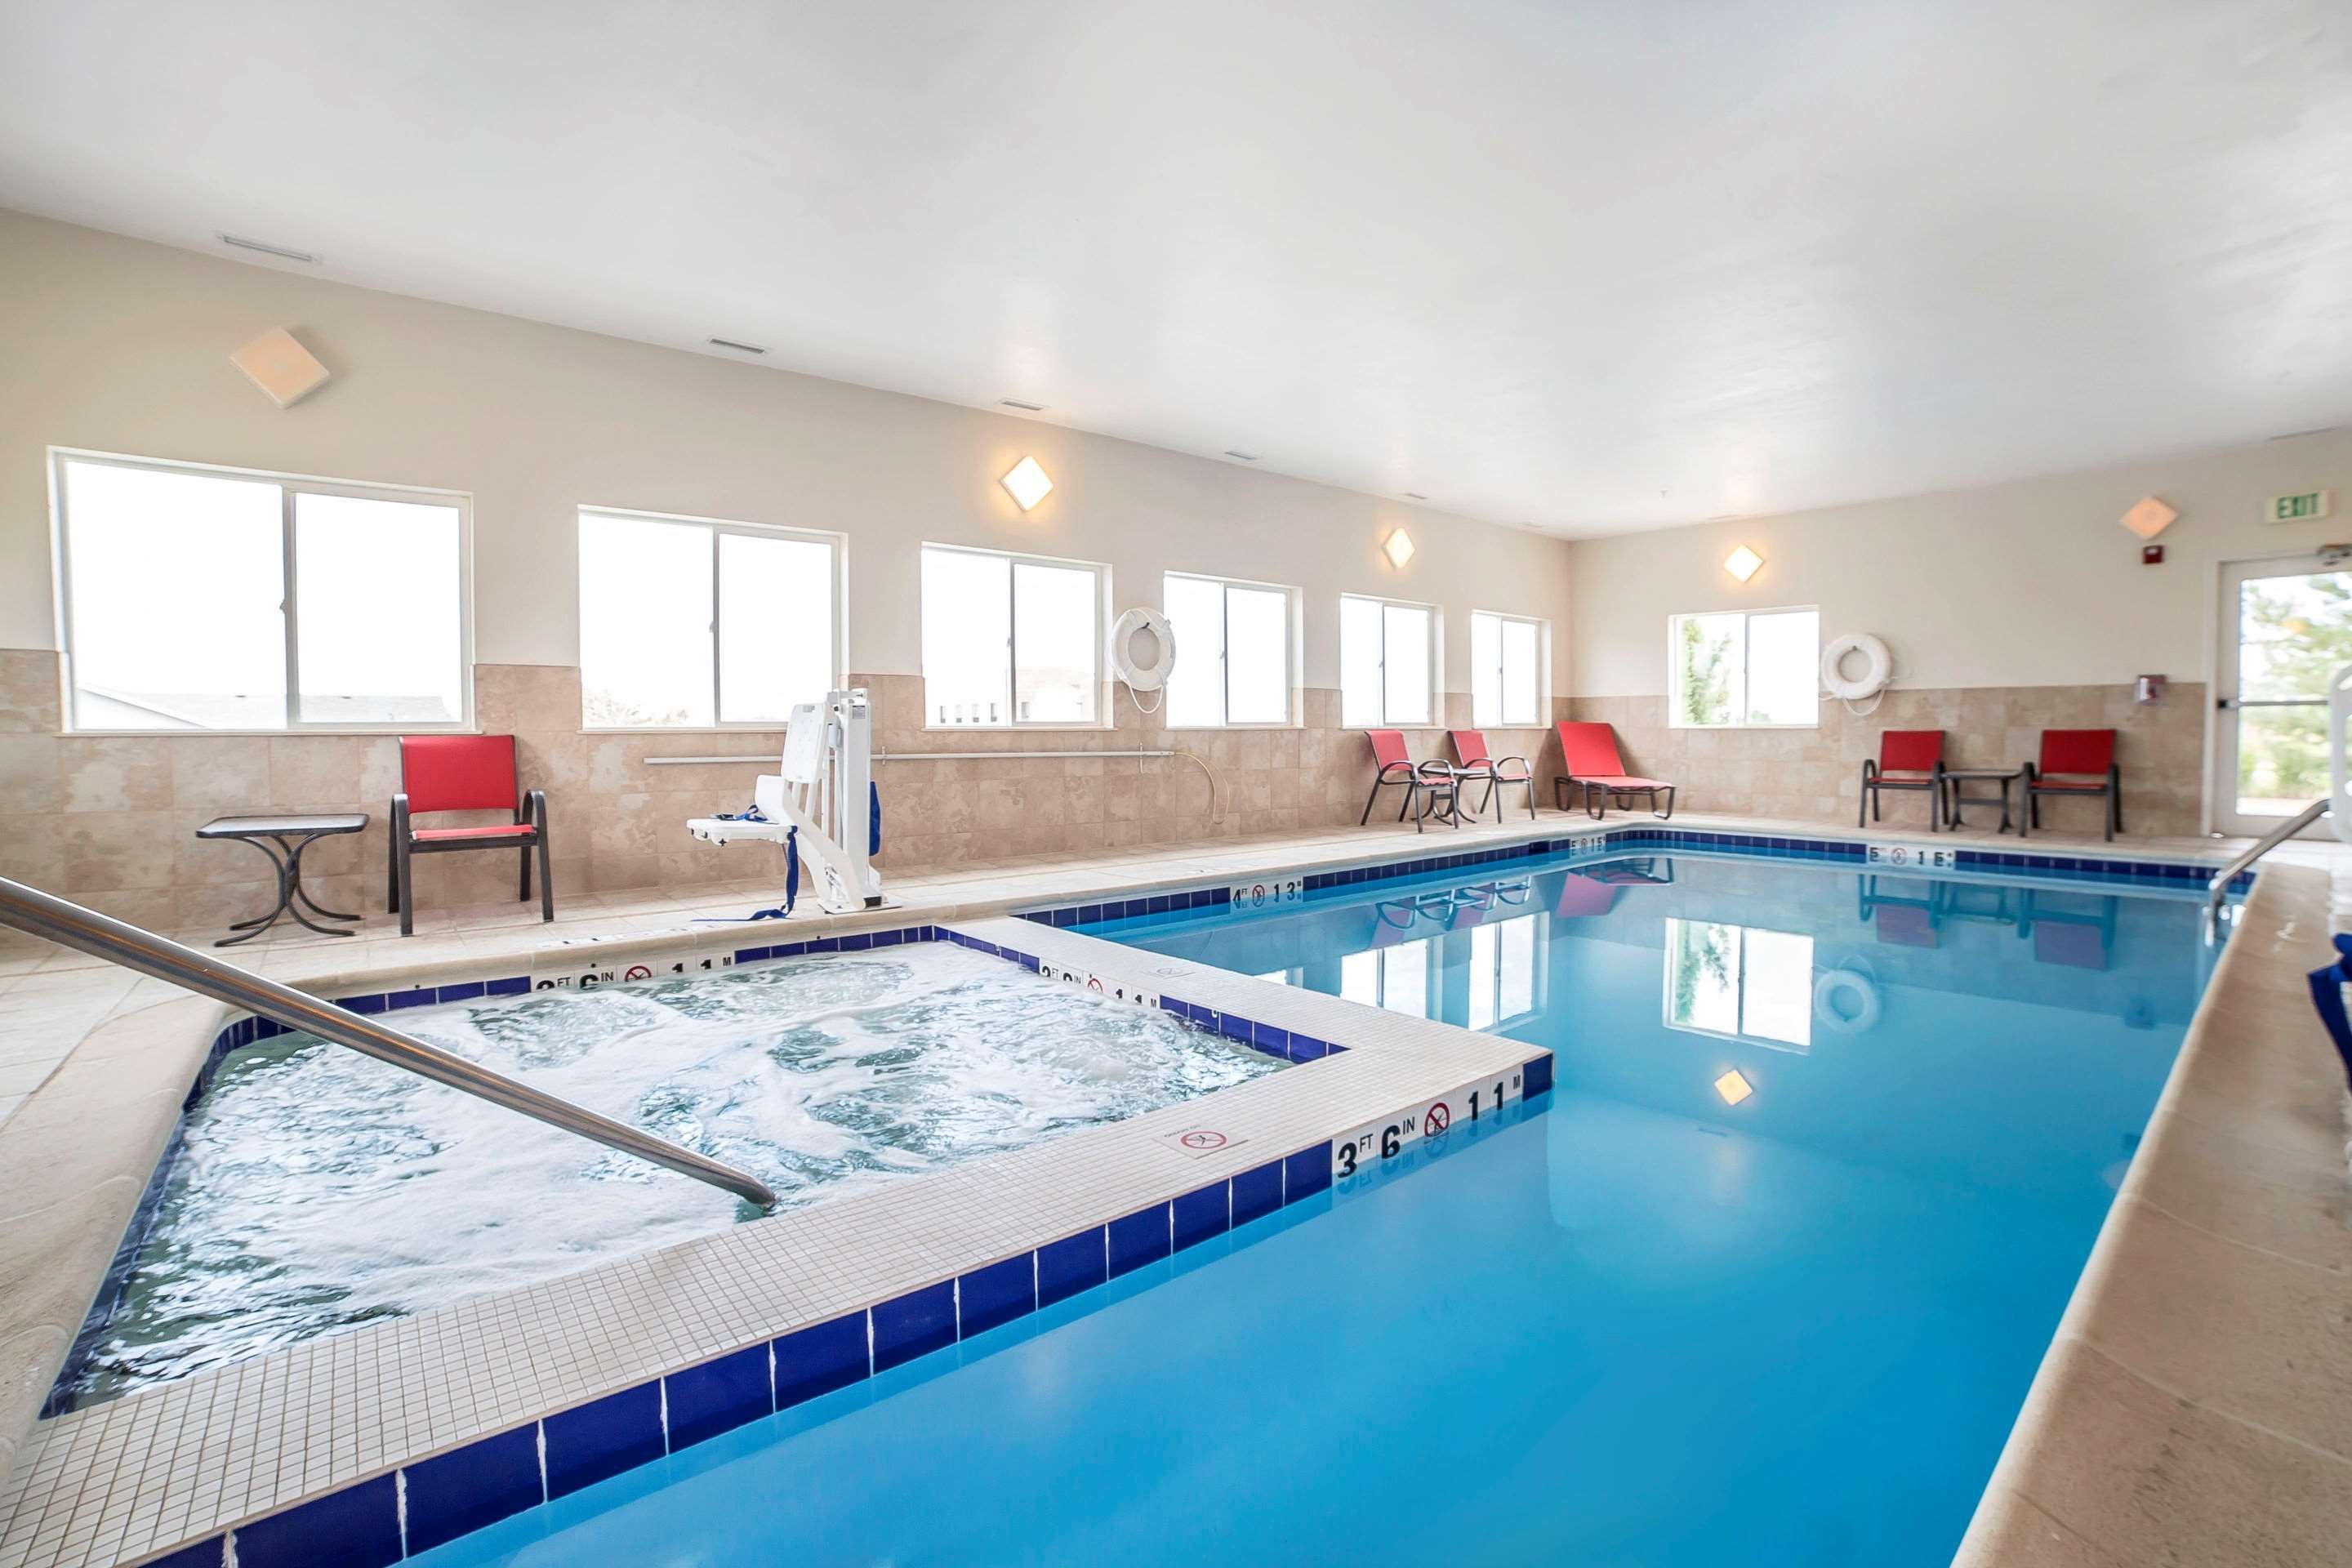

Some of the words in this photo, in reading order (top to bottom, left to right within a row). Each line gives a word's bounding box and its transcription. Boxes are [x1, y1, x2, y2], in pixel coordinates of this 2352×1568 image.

[2277, 493, 2318, 519] EXIT
[600, 972, 613, 982] IN
[723, 956, 731, 966] M
[1151, 998, 1156, 1008] M
[1338, 1143, 1357, 1178] 3
[1360, 1133, 1374, 1153] FT
[1381, 1125, 1401, 1159] 6
[1402, 1116, 1415, 1135] IN
[1513, 1075, 1521, 1089] M
